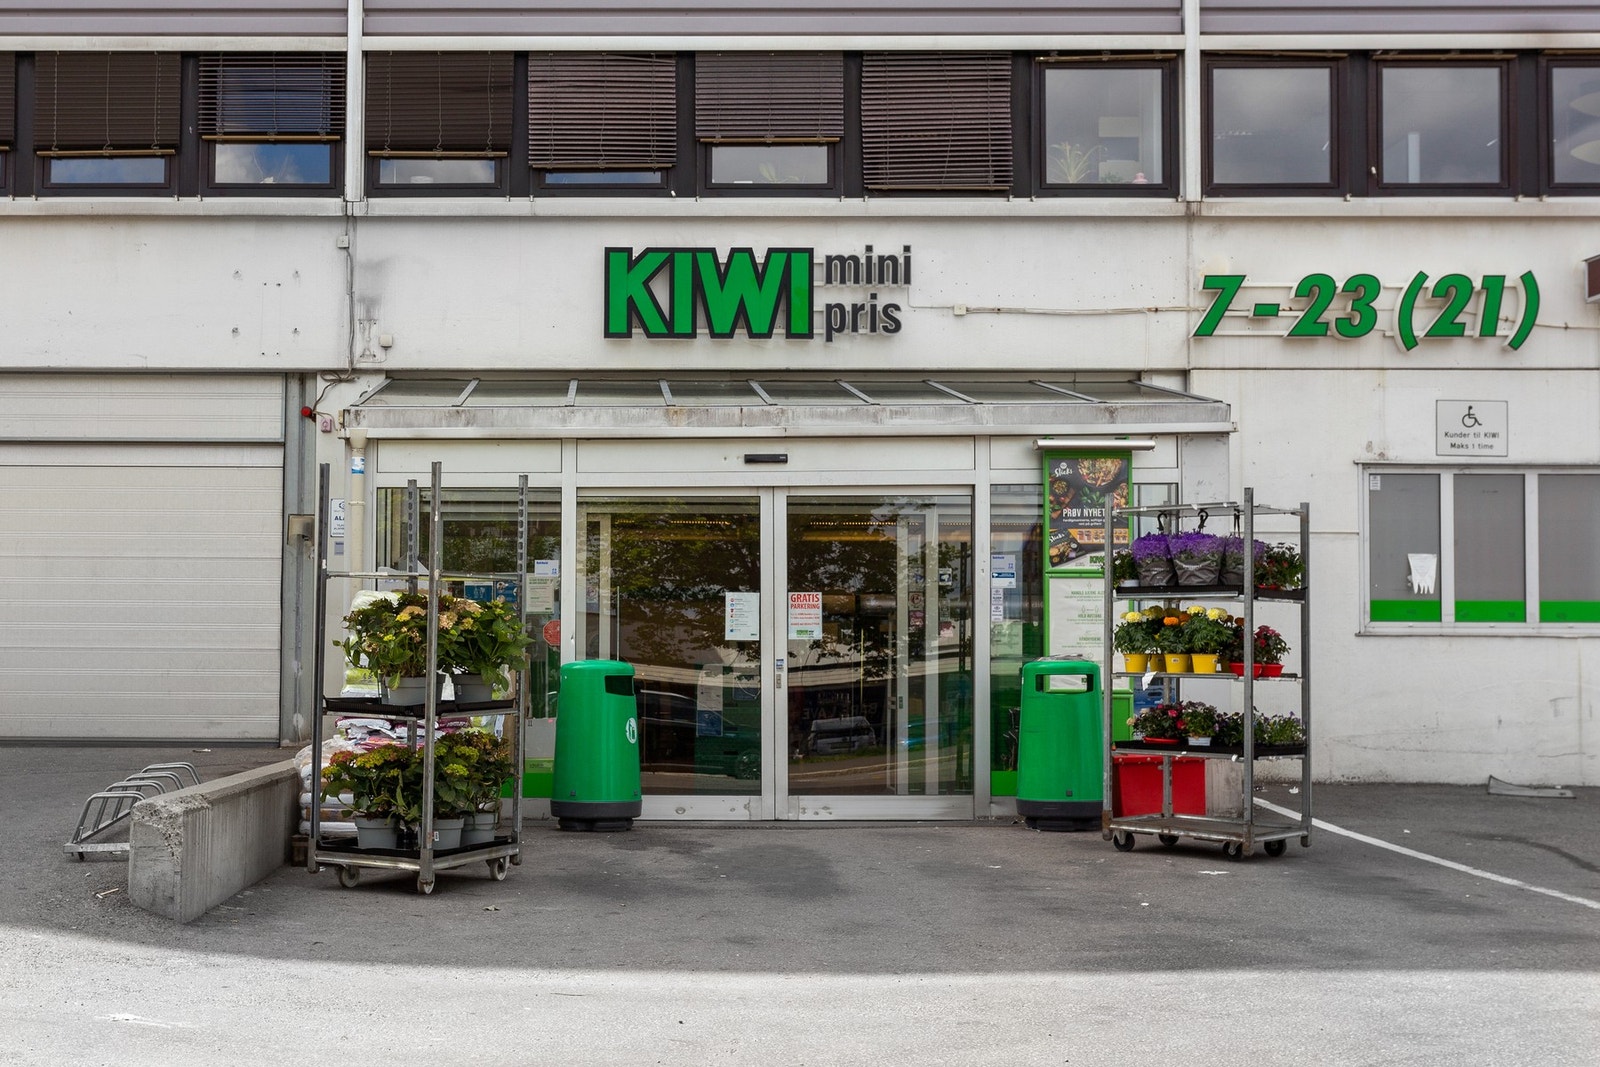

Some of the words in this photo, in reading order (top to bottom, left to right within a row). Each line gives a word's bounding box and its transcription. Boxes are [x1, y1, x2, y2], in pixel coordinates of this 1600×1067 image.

[825, 245, 912, 285] mini
[604, 247, 814, 339] KIWI
[1397, 270, 1541, 352] (21)
[825, 293, 902, 342] pris
[1063, 508, 1082, 517] PRØV
[1089, 555, 1105, 564] KIW
[791, 593, 820, 603] GRATIS
